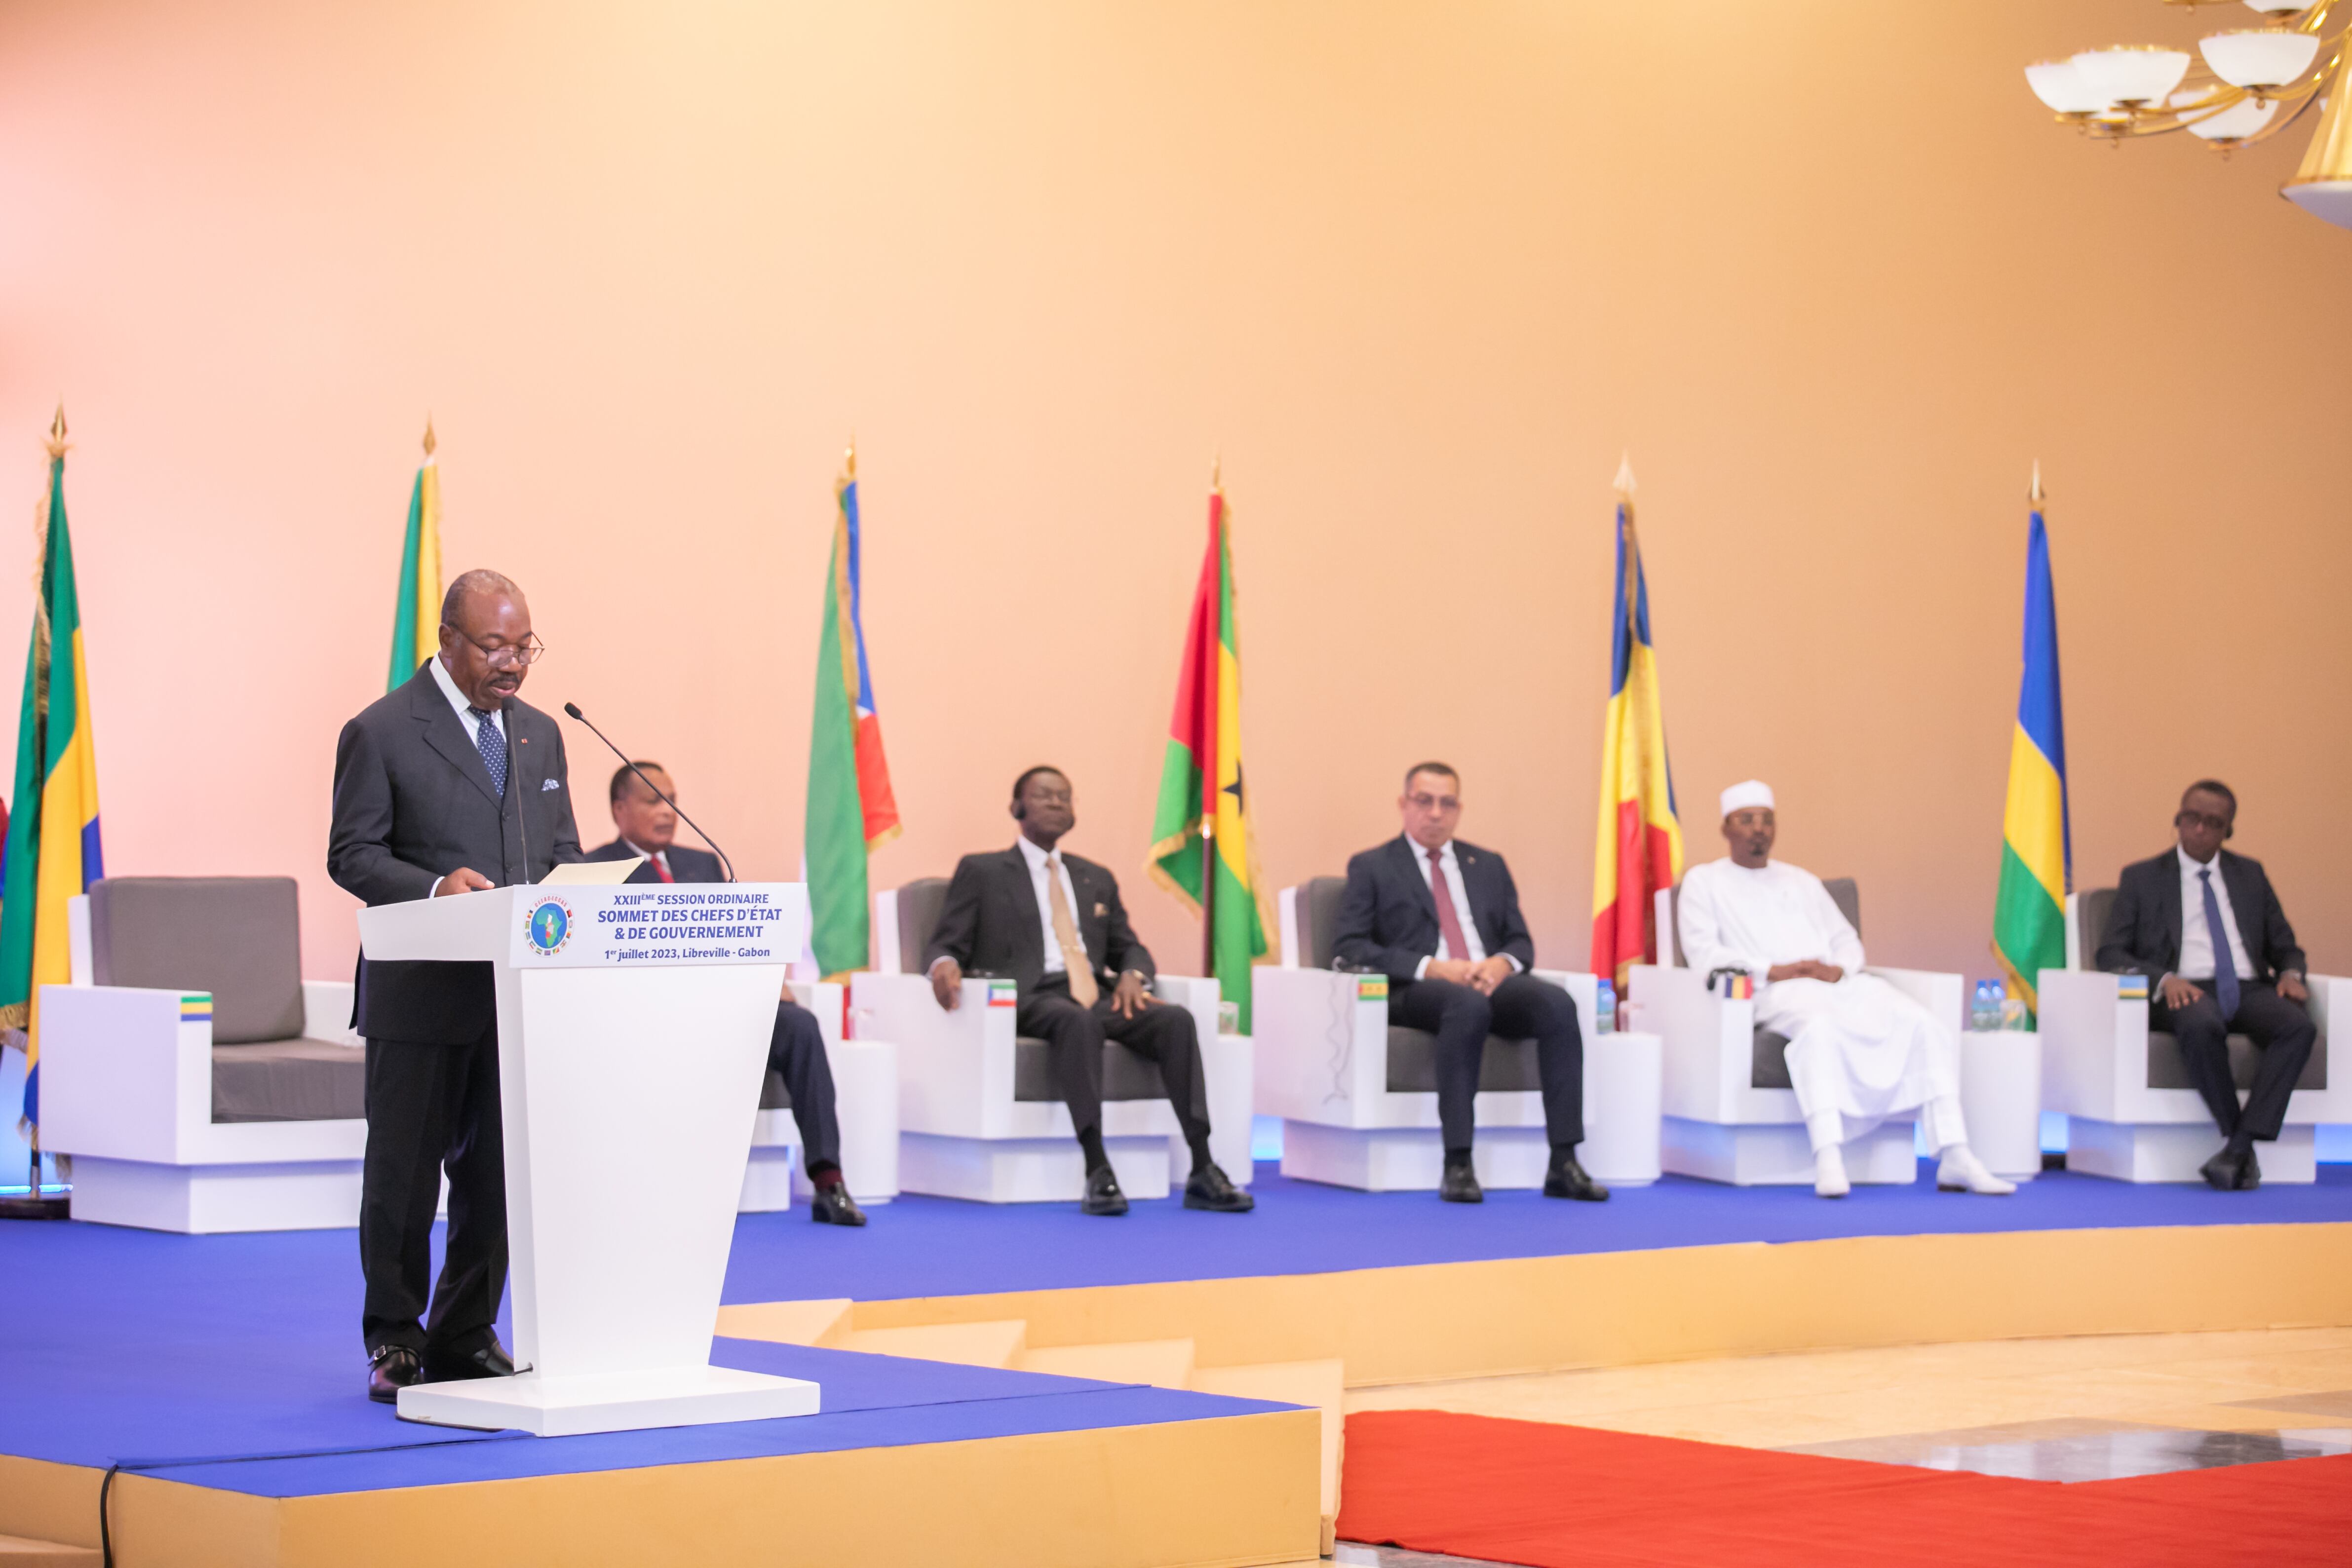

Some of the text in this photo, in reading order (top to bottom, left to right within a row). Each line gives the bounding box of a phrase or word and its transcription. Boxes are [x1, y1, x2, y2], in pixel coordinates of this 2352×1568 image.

[657, 894, 705, 905] SESSION
[708, 894, 769, 904] ORDINAIRE
[598, 905, 782, 922] SOMMET DES CHEFS D'ÉTAT
[615, 926, 763, 939] & DE GOUVERNEMENT
[605, 950, 617, 959] 1er
[617, 949, 649, 961] juillet
[651, 949, 680, 959] 2023,
[683, 947, 730, 957] Libreville
[738, 948, 770, 957] Gabon
